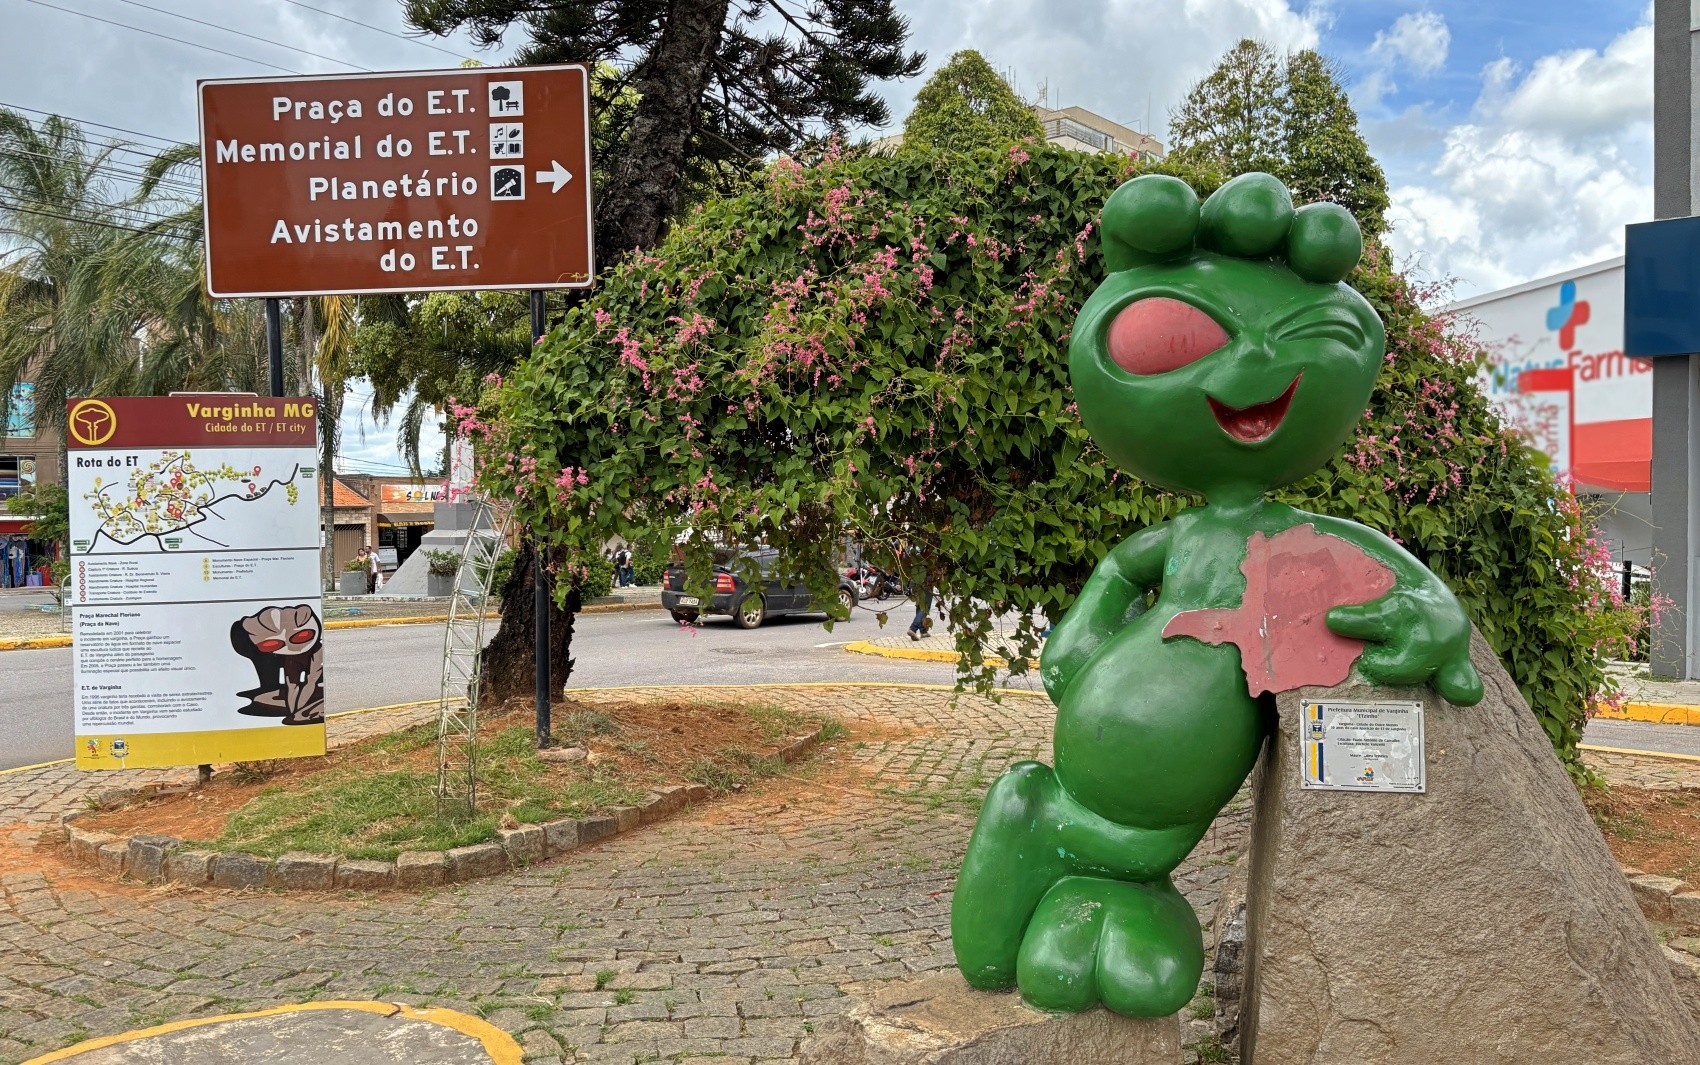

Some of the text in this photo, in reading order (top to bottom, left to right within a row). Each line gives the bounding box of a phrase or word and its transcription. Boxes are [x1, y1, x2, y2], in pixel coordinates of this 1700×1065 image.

[273, 89, 476, 123] Praça do E.T.
[216, 130, 476, 164] Memorial do E.T.
[310, 170, 478, 201] Planetário
[270, 214, 478, 244] Avistamento
[380, 246, 480, 272] do E.T.
[186, 403, 314, 420] Varginha MG
[205, 423, 238, 433] Cidade
[241, 423, 252, 432] do
[256, 423, 266, 432] ET
[277, 423, 287, 432] ET
[290, 423, 306, 434] city
[77, 456, 138, 467] Rota do ET
